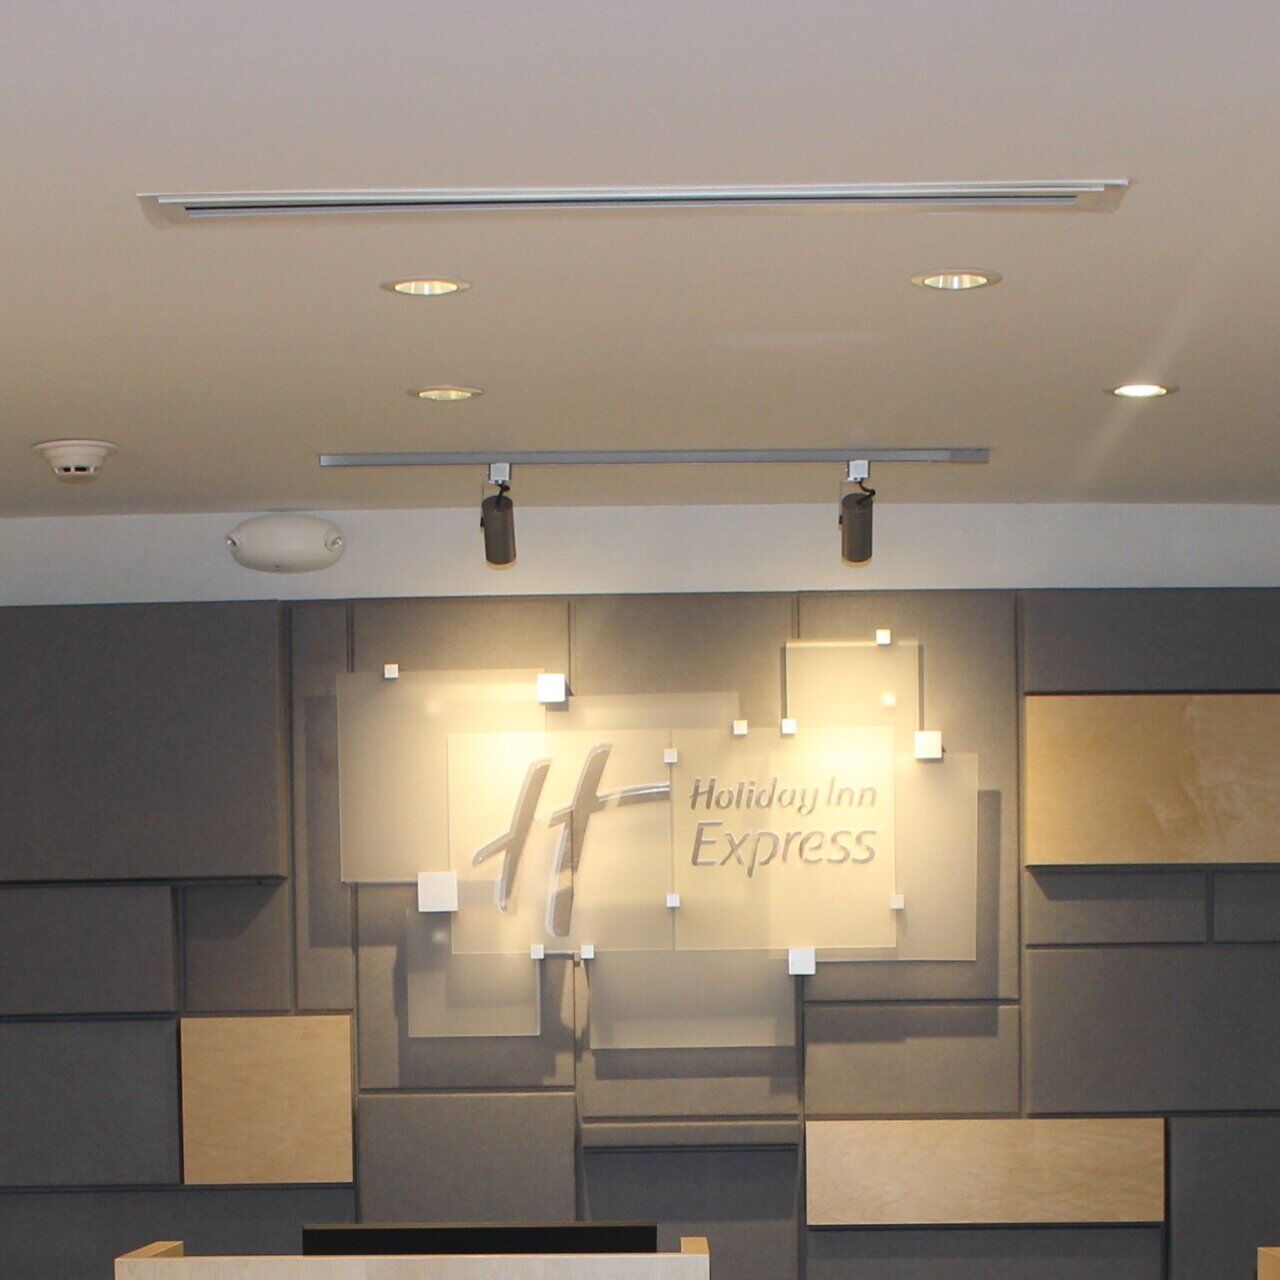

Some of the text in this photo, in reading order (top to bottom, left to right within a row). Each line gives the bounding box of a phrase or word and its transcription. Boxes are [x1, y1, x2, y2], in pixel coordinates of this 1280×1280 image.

[689, 776, 877, 815] Holiday Inn
[691, 821, 876, 878] Express
